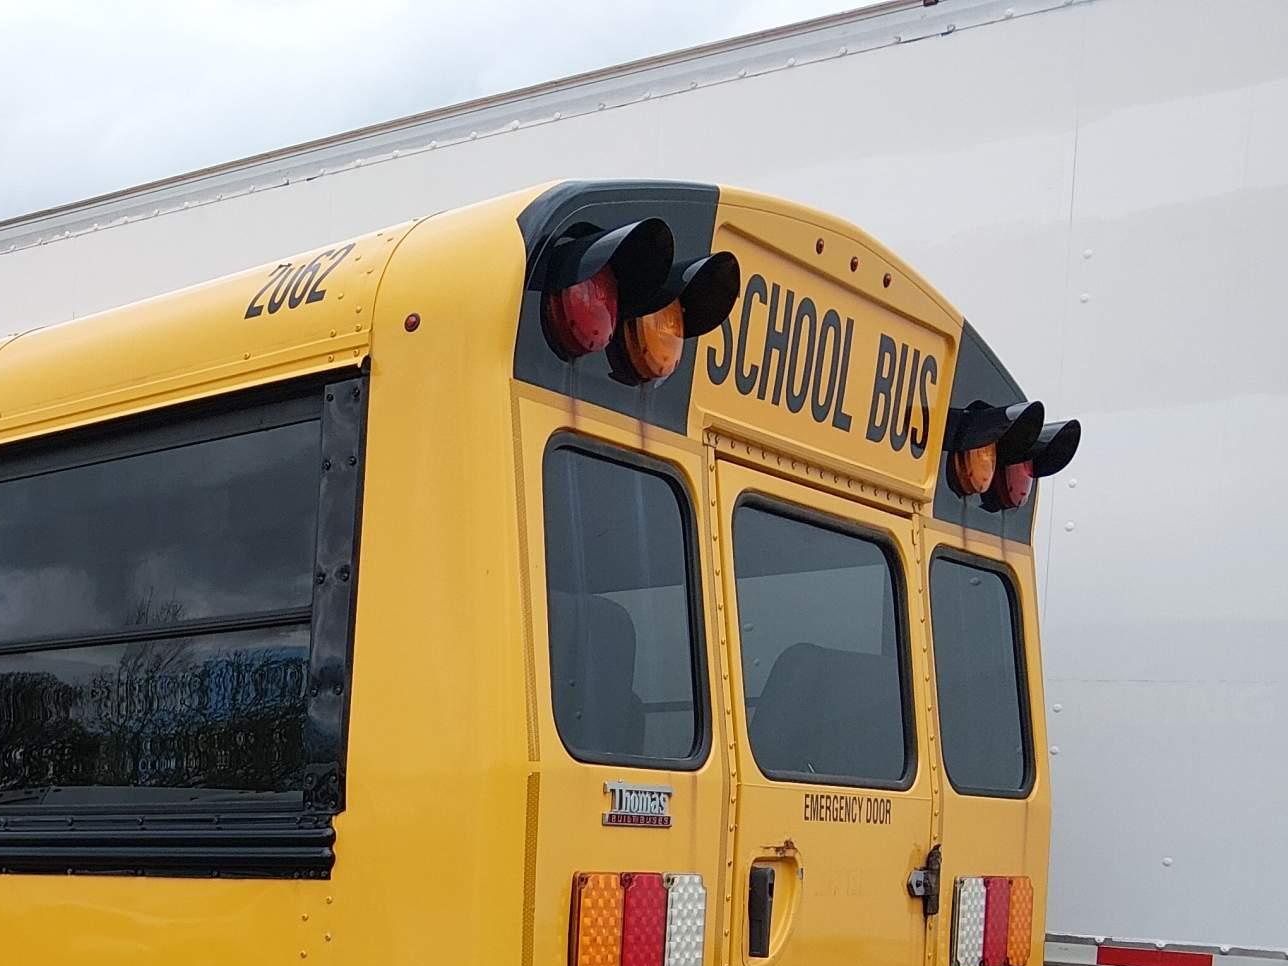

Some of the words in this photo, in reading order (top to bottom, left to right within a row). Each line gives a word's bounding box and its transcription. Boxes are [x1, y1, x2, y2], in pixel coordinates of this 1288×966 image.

[244, 242, 356, 319] 2062
[706, 273, 855, 432] SCHOOL
[865, 333, 938, 459] BUS
[603, 783, 675, 816] Thomas
[804, 793, 864, 824] EMERGENCY
[866, 797, 892, 824] DOOR
